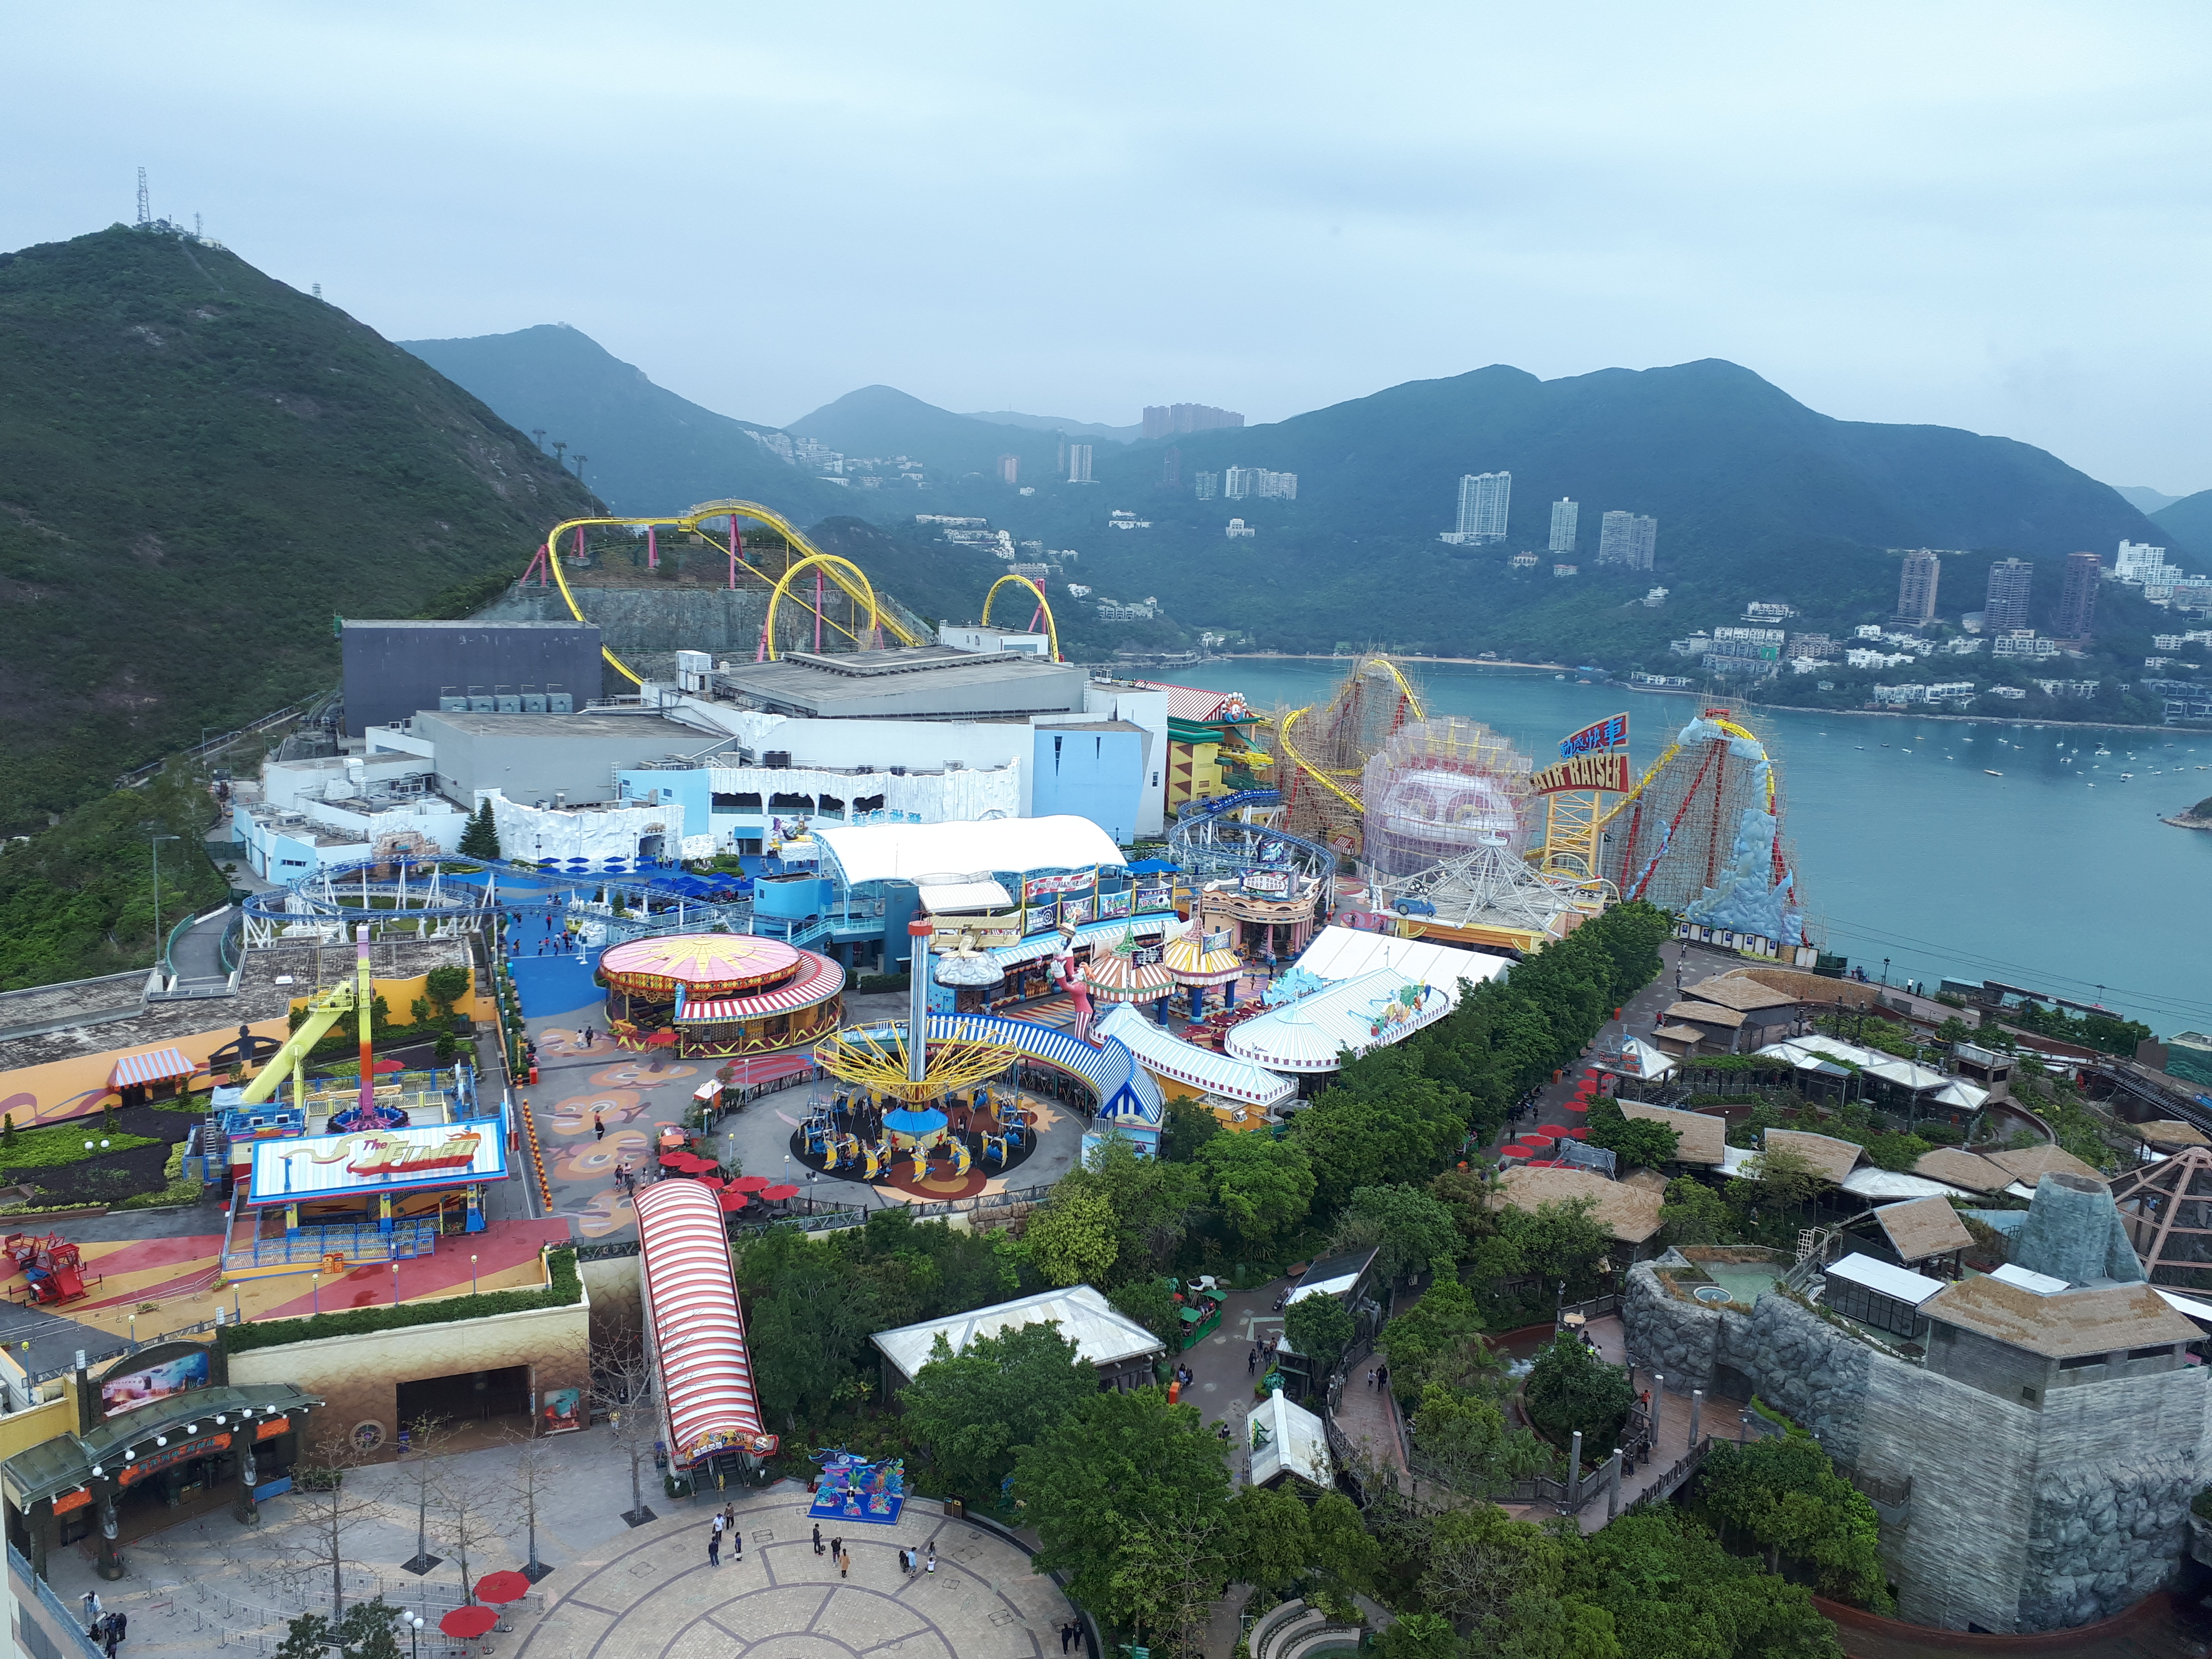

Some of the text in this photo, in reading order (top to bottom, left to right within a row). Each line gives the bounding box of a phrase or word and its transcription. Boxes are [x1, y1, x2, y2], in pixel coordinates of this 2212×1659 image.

[1559, 717, 1628, 759] 動感快車
[1568, 753, 1621, 790] RAISER
[1599, 1055, 1619, 1063] Rapids
[363, 1138, 479, 1167] The FLASH
